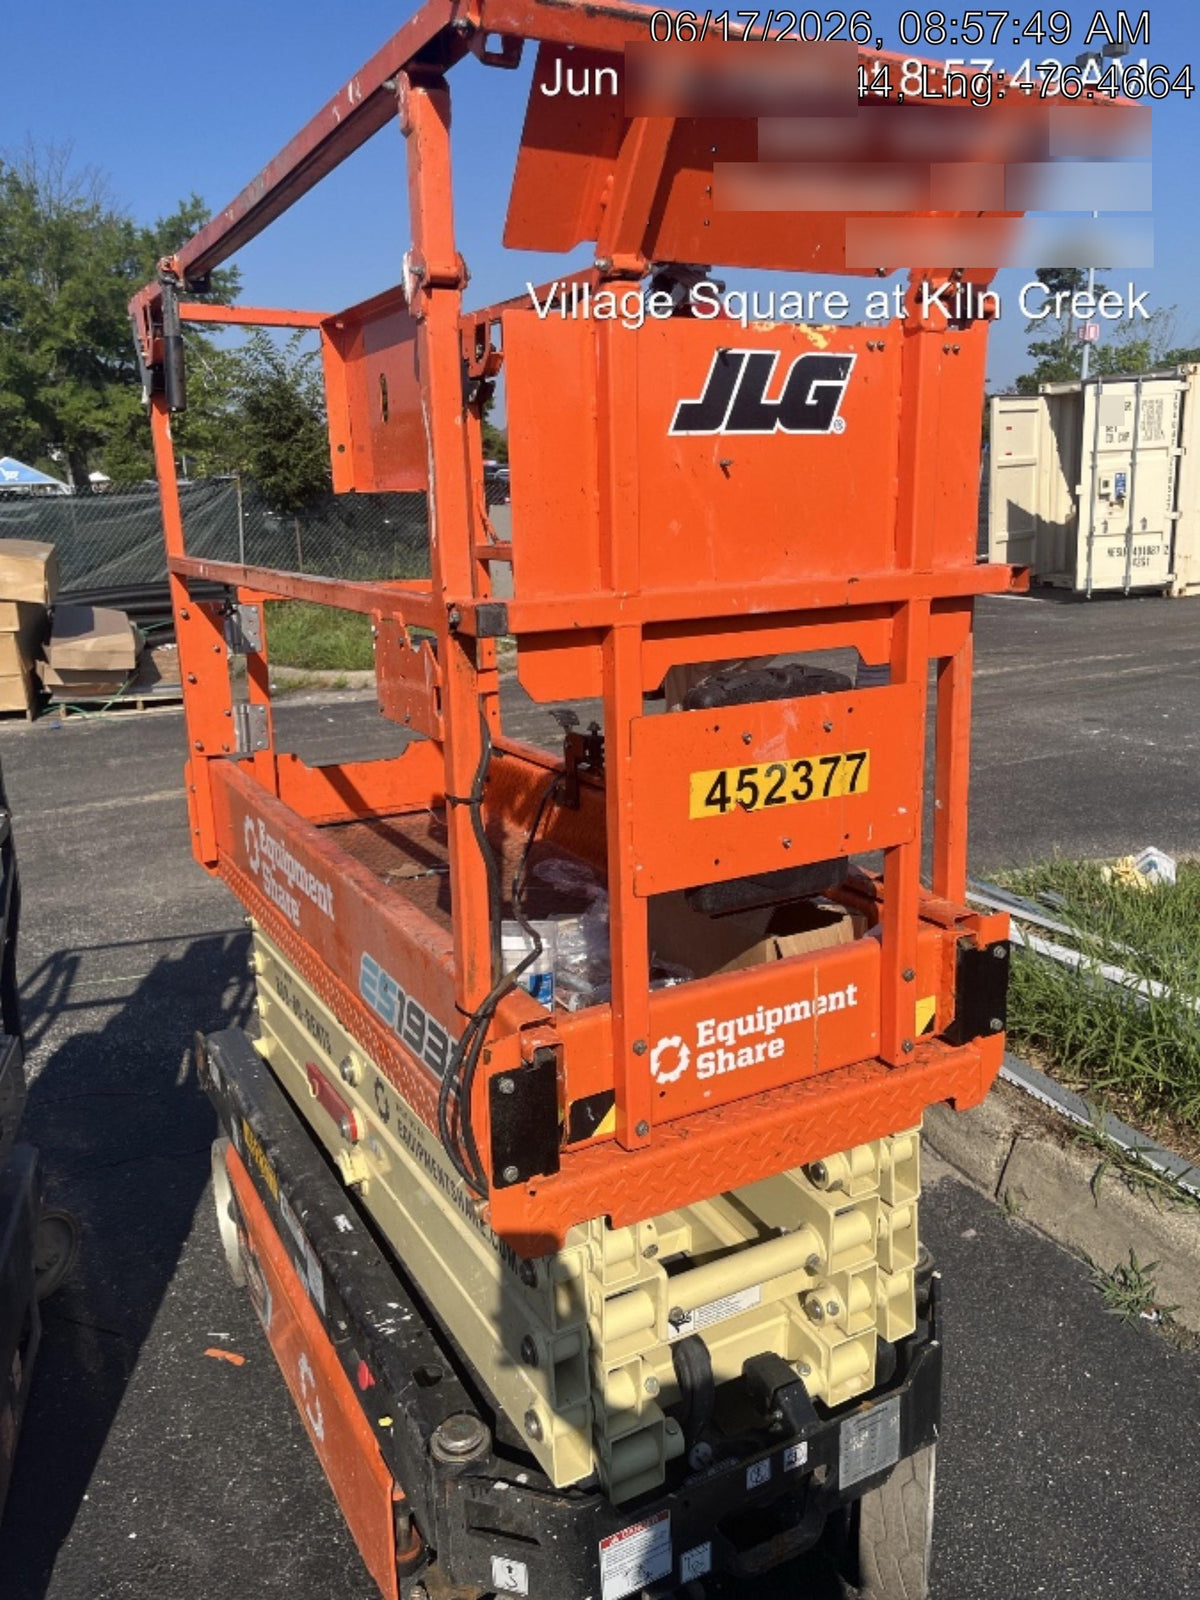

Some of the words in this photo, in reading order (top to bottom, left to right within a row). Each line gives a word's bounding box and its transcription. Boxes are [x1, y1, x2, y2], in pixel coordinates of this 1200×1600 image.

[667, 348, 857, 436] JLG
[704, 751, 867, 814] 452377
[256, 816, 335, 922] Equipment
[261, 860, 301, 927] Share
[696, 982, 858, 1048] Equipment
[696, 1037, 786, 1080] Share
